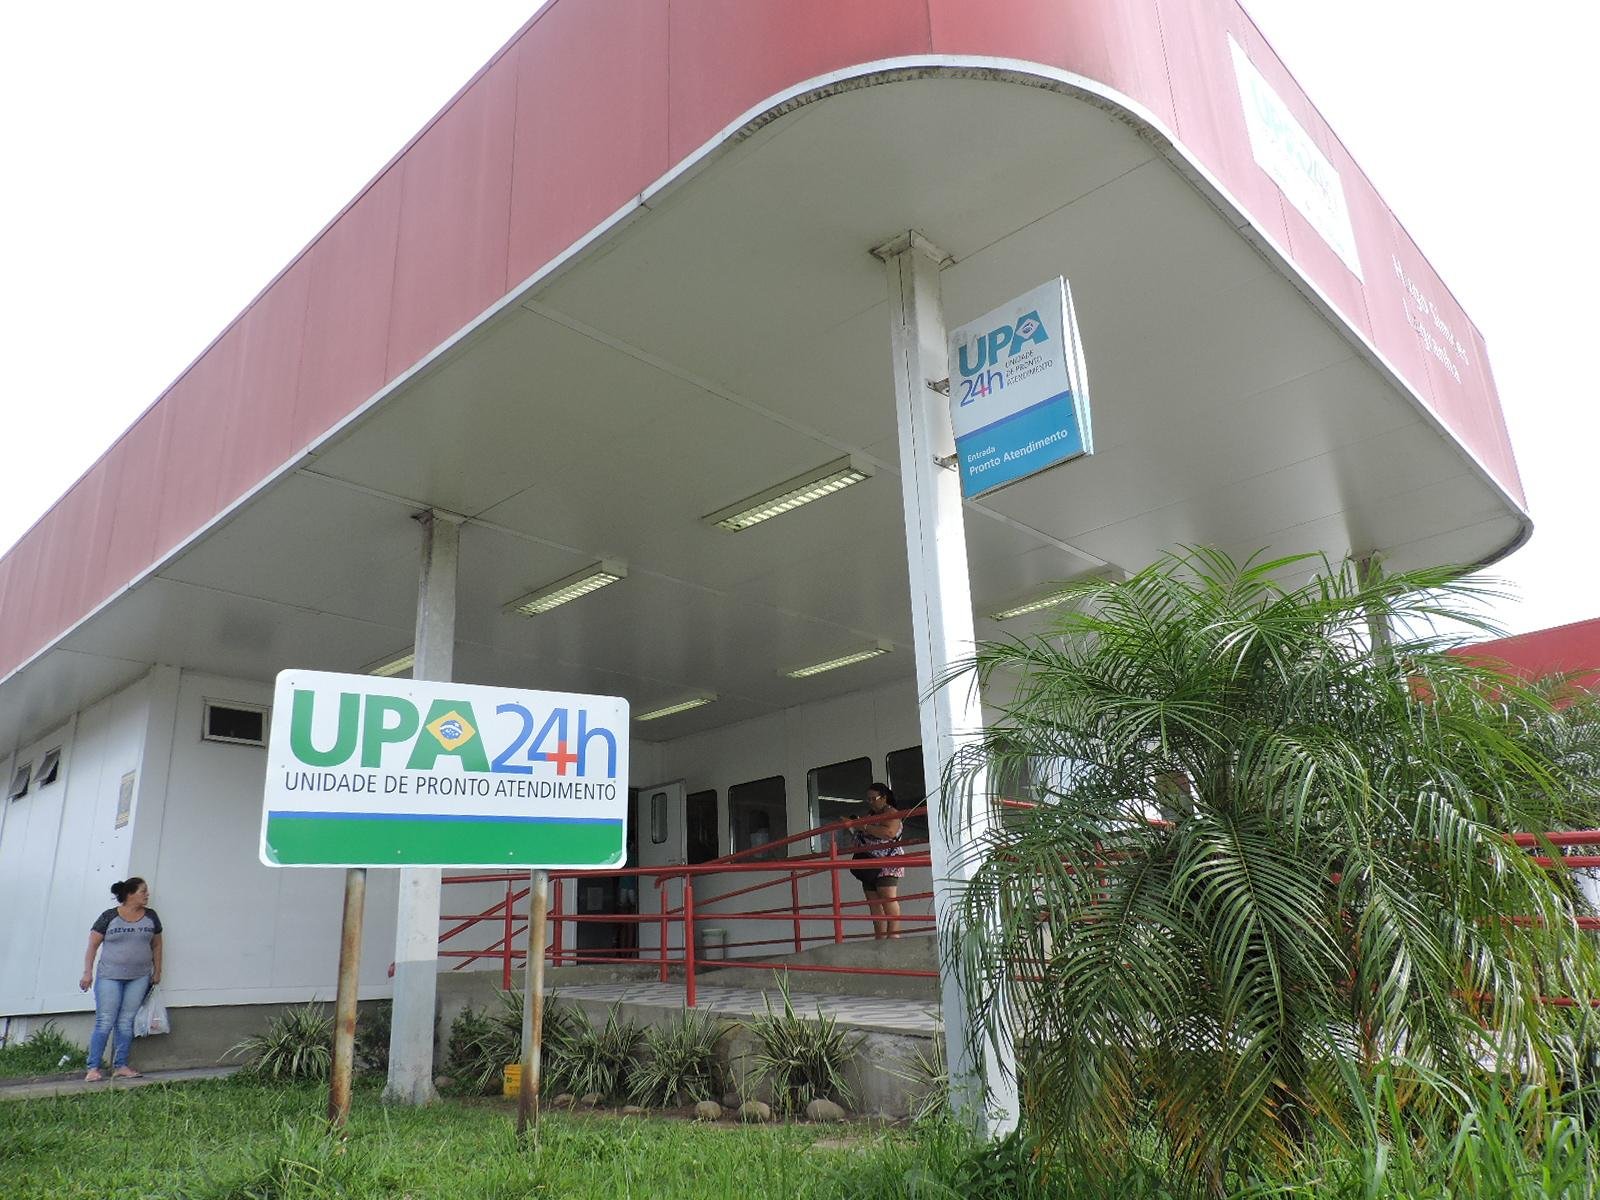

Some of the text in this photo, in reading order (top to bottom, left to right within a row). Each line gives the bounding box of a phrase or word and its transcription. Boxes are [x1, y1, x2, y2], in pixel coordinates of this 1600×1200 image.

[958, 310, 1049, 378] UPA
[1005, 350, 1034, 369] UNIDADE
[1006, 356, 1043, 378] DE PRONTO
[1006, 359, 1053, 386] ATENDIMENTO
[959, 369, 1004, 408] 24h
[967, 446, 996, 462] Entrada
[969, 429, 1068, 476] Pronto Atendimento
[290, 689, 617, 779] UPA 24h
[285, 771, 617, 801] UNIDADE DE PRONTO ATENDIMENTO
